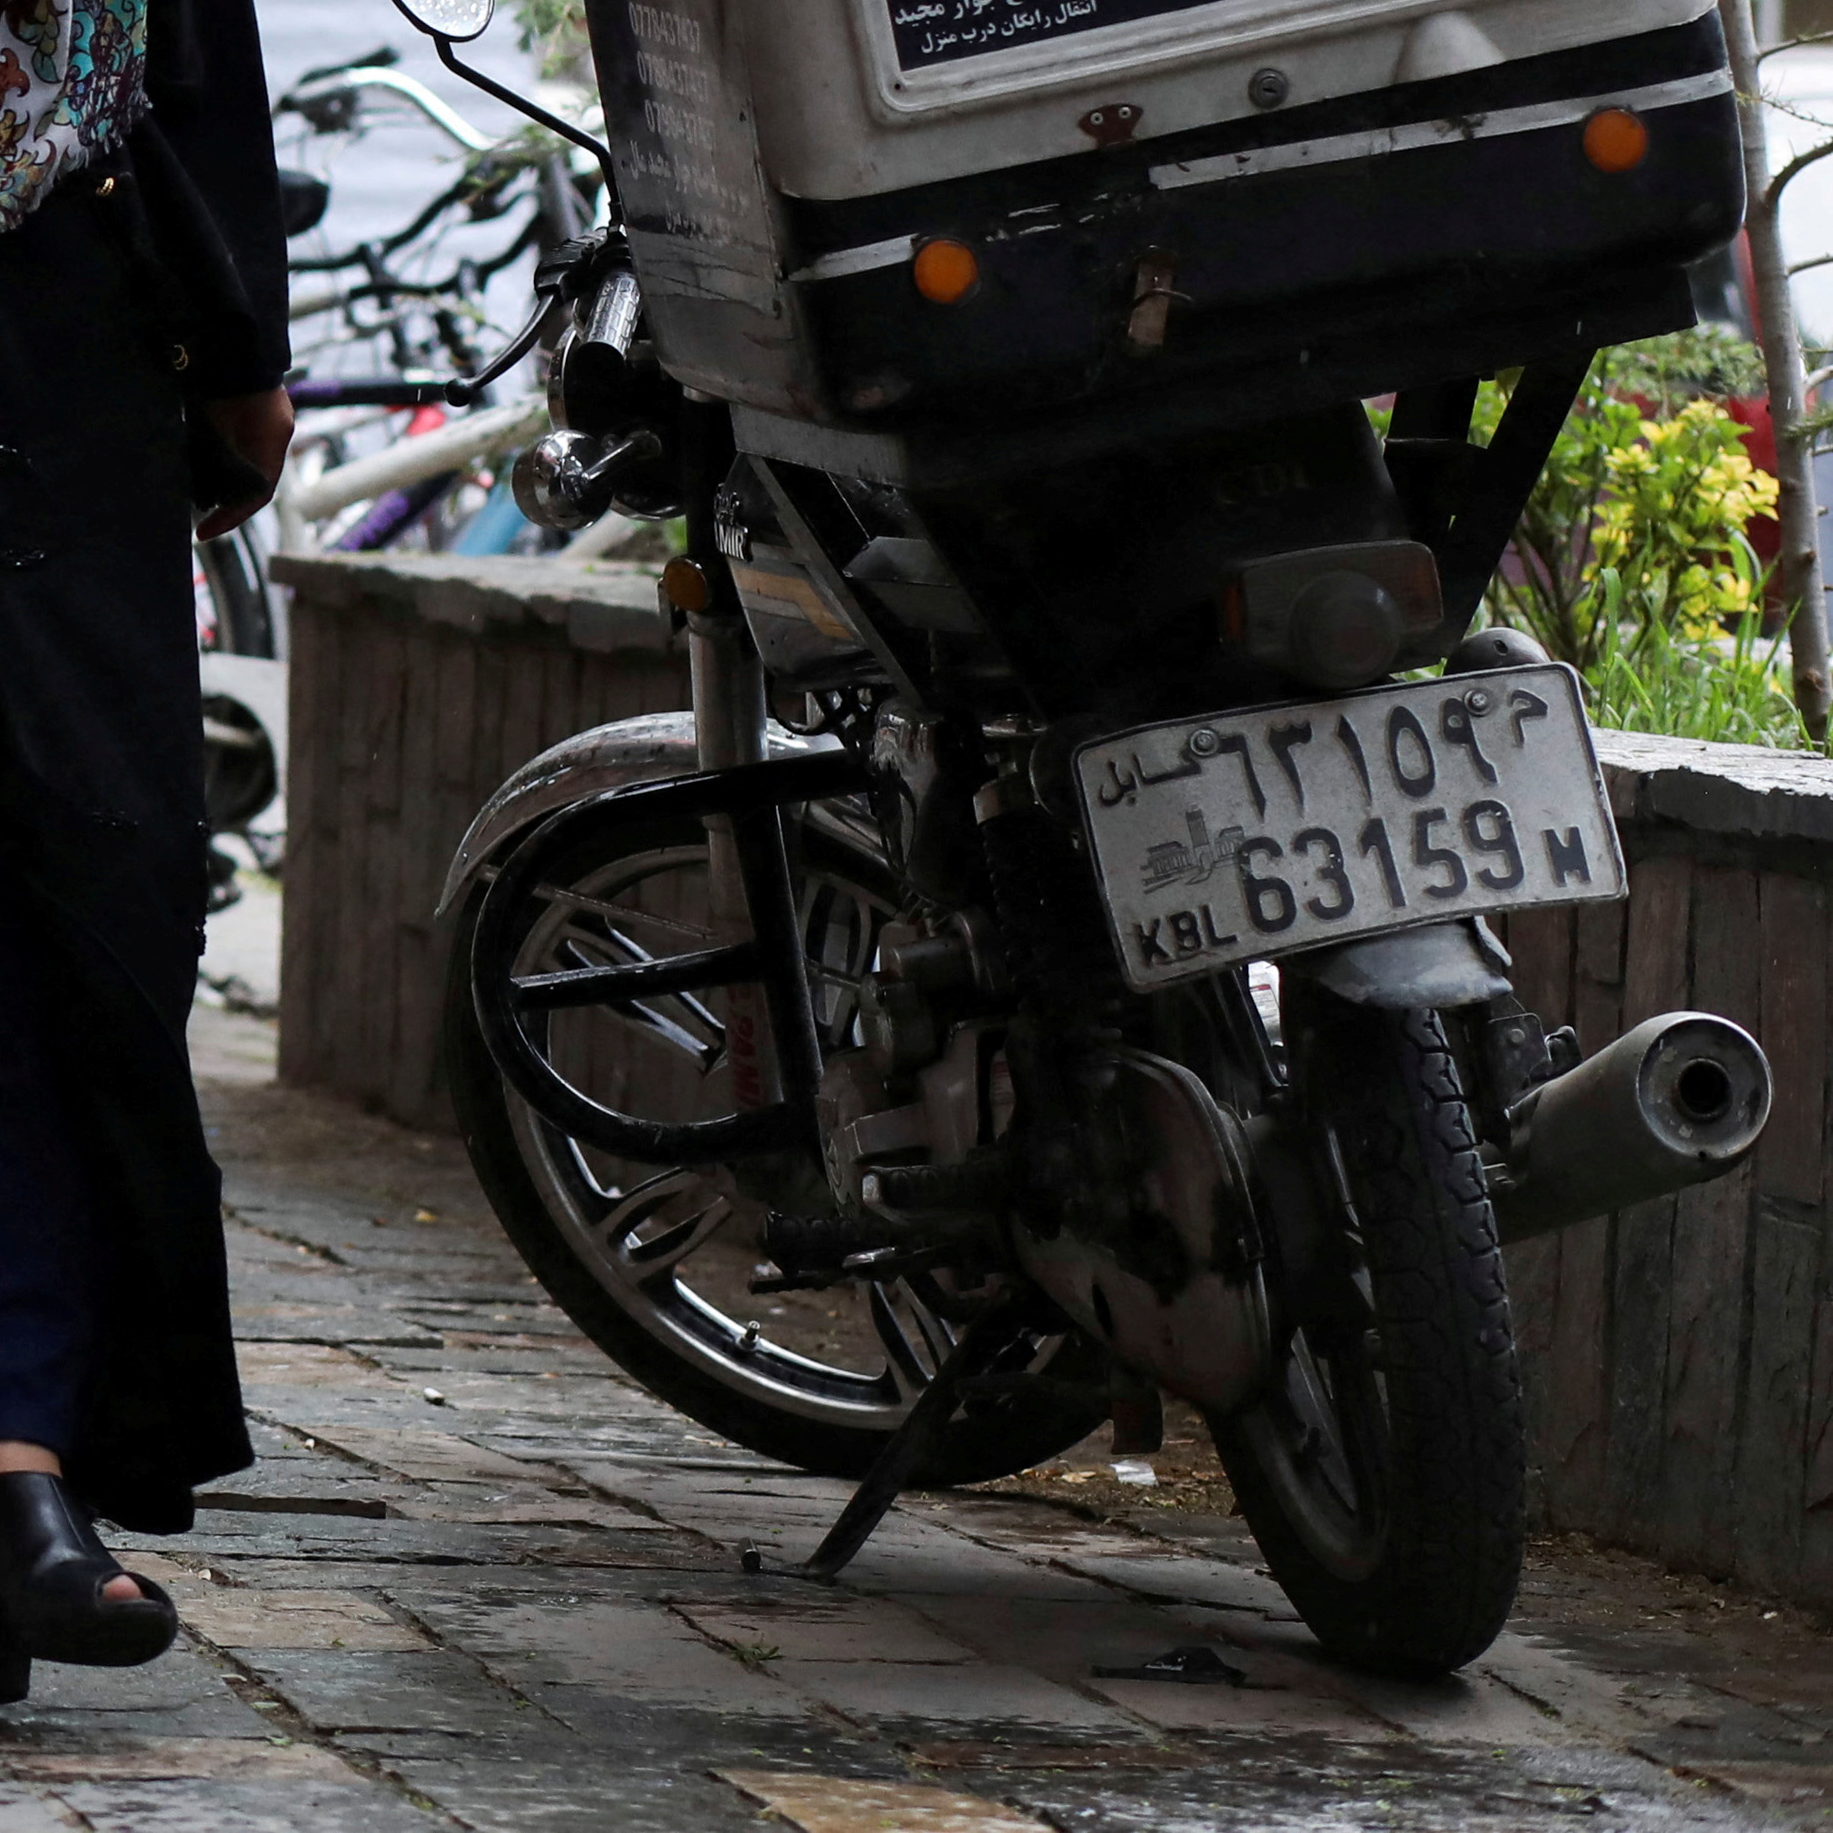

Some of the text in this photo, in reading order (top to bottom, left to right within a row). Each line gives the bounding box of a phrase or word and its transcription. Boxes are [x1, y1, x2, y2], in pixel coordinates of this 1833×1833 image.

[894, 1, 945, 28] مجید
[920, 31, 958, 54] منزل
[961, 21, 996, 43] درب
[1133, 902, 1239, 967] KBL
[1240, 798, 1526, 934] 63159
